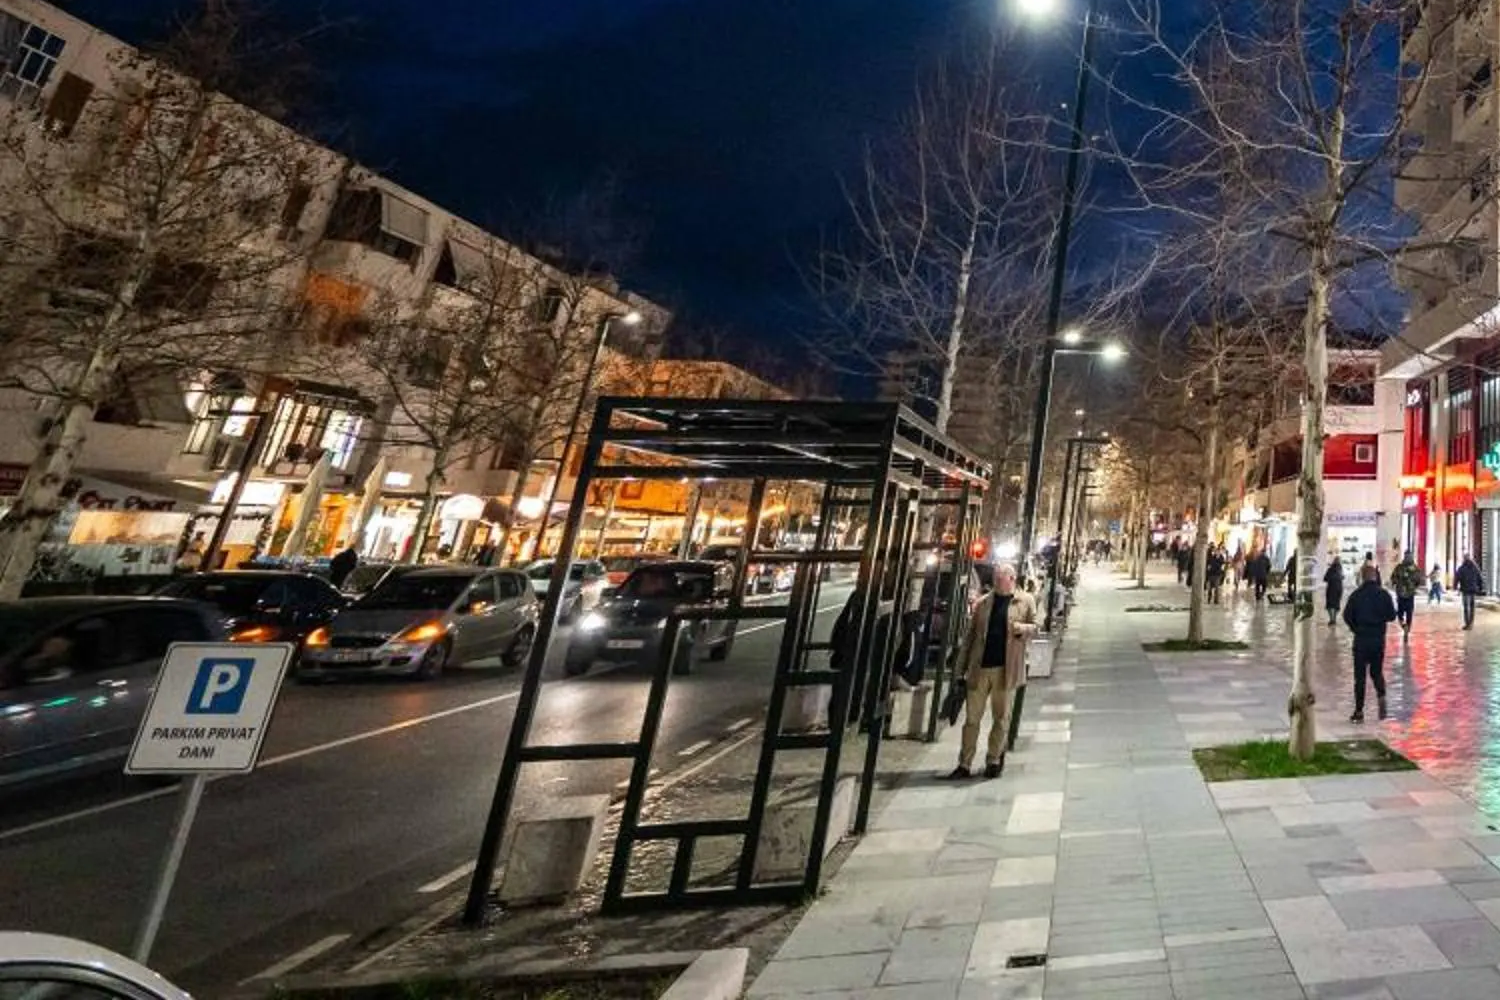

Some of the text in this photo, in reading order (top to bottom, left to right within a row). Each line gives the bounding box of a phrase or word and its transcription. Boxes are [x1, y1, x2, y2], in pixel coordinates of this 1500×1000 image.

[200, 664, 240, 709] P
[151, 727, 257, 740] PARKIM PRIVAT
[178, 746, 215, 759] DANI
